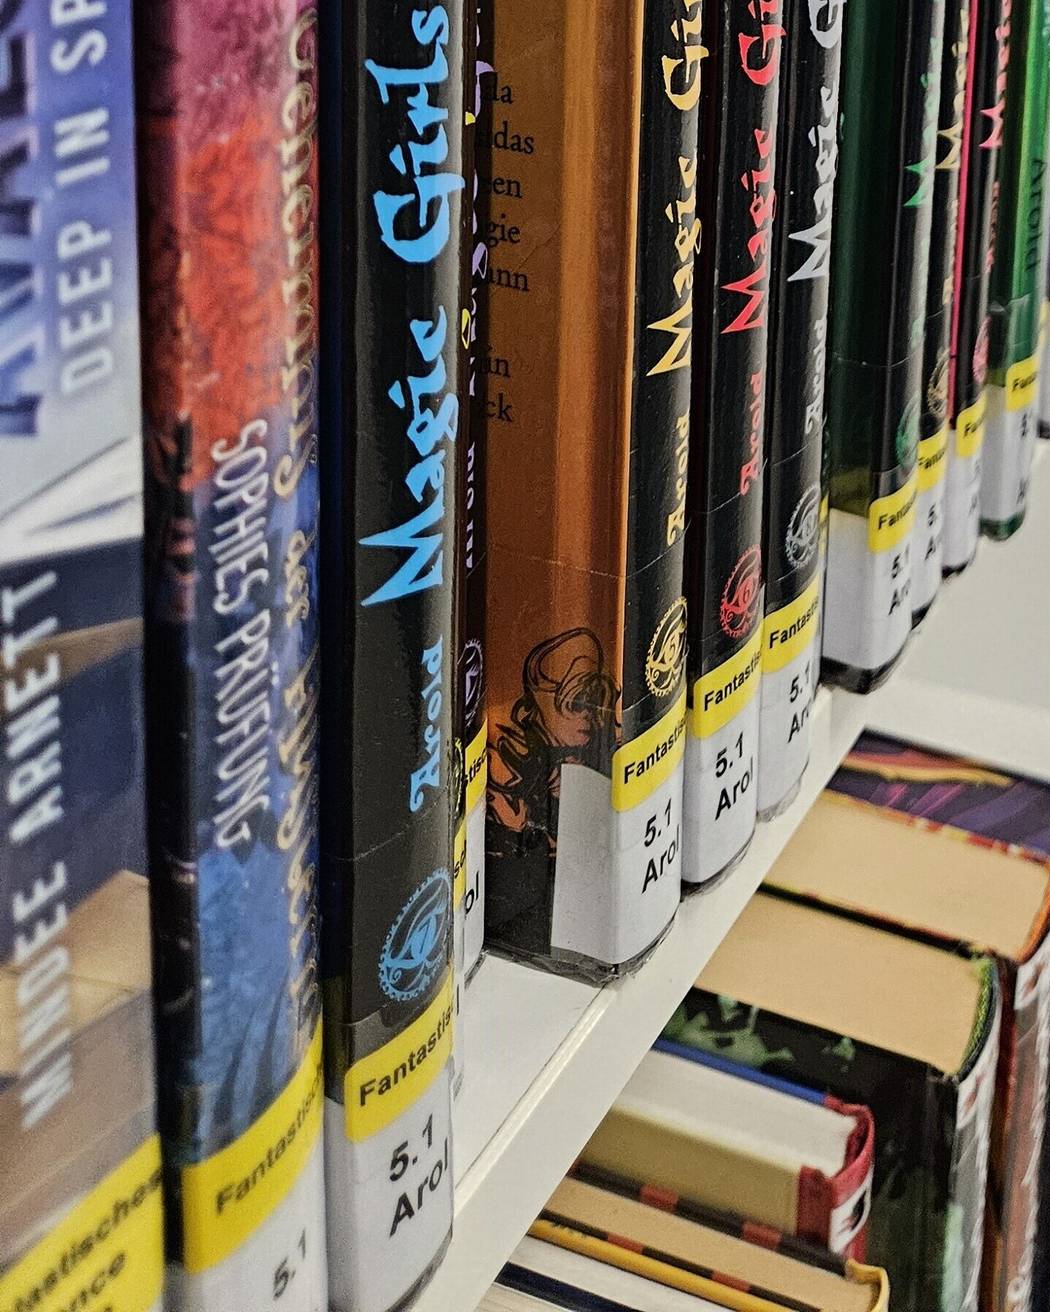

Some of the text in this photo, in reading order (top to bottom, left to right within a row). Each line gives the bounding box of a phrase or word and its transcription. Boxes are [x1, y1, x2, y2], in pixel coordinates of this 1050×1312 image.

[54, 105, 111, 187] IN
[365, 4, 465, 265] Girls
[787, 85, 838, 282] Magic
[646, 153, 702, 377] Magic
[721, 128, 776, 335] Magic
[56, 215, 115, 395] DEEP
[740, 371, 762, 497] Arold
[804, 318, 826, 435] Arold
[358, 304, 459, 607] Magic
[667, 413, 690, 547] Arold
[209, 419, 280, 849] SOPHIES PRÜFUNG
[410, 635, 444, 813] Arold
[715, 731, 744, 779] 5.1
[715, 756, 754, 821] Arol
[1, 570, 75, 1130] MINDEE ARNETT
[642, 825, 680, 895] Arol
[643, 798, 672, 848] 5.1
[389, 1137, 449, 1239] Arol
[390, 1112, 433, 1183] 5.1
[272, 1225, 307, 1302] 5.1
